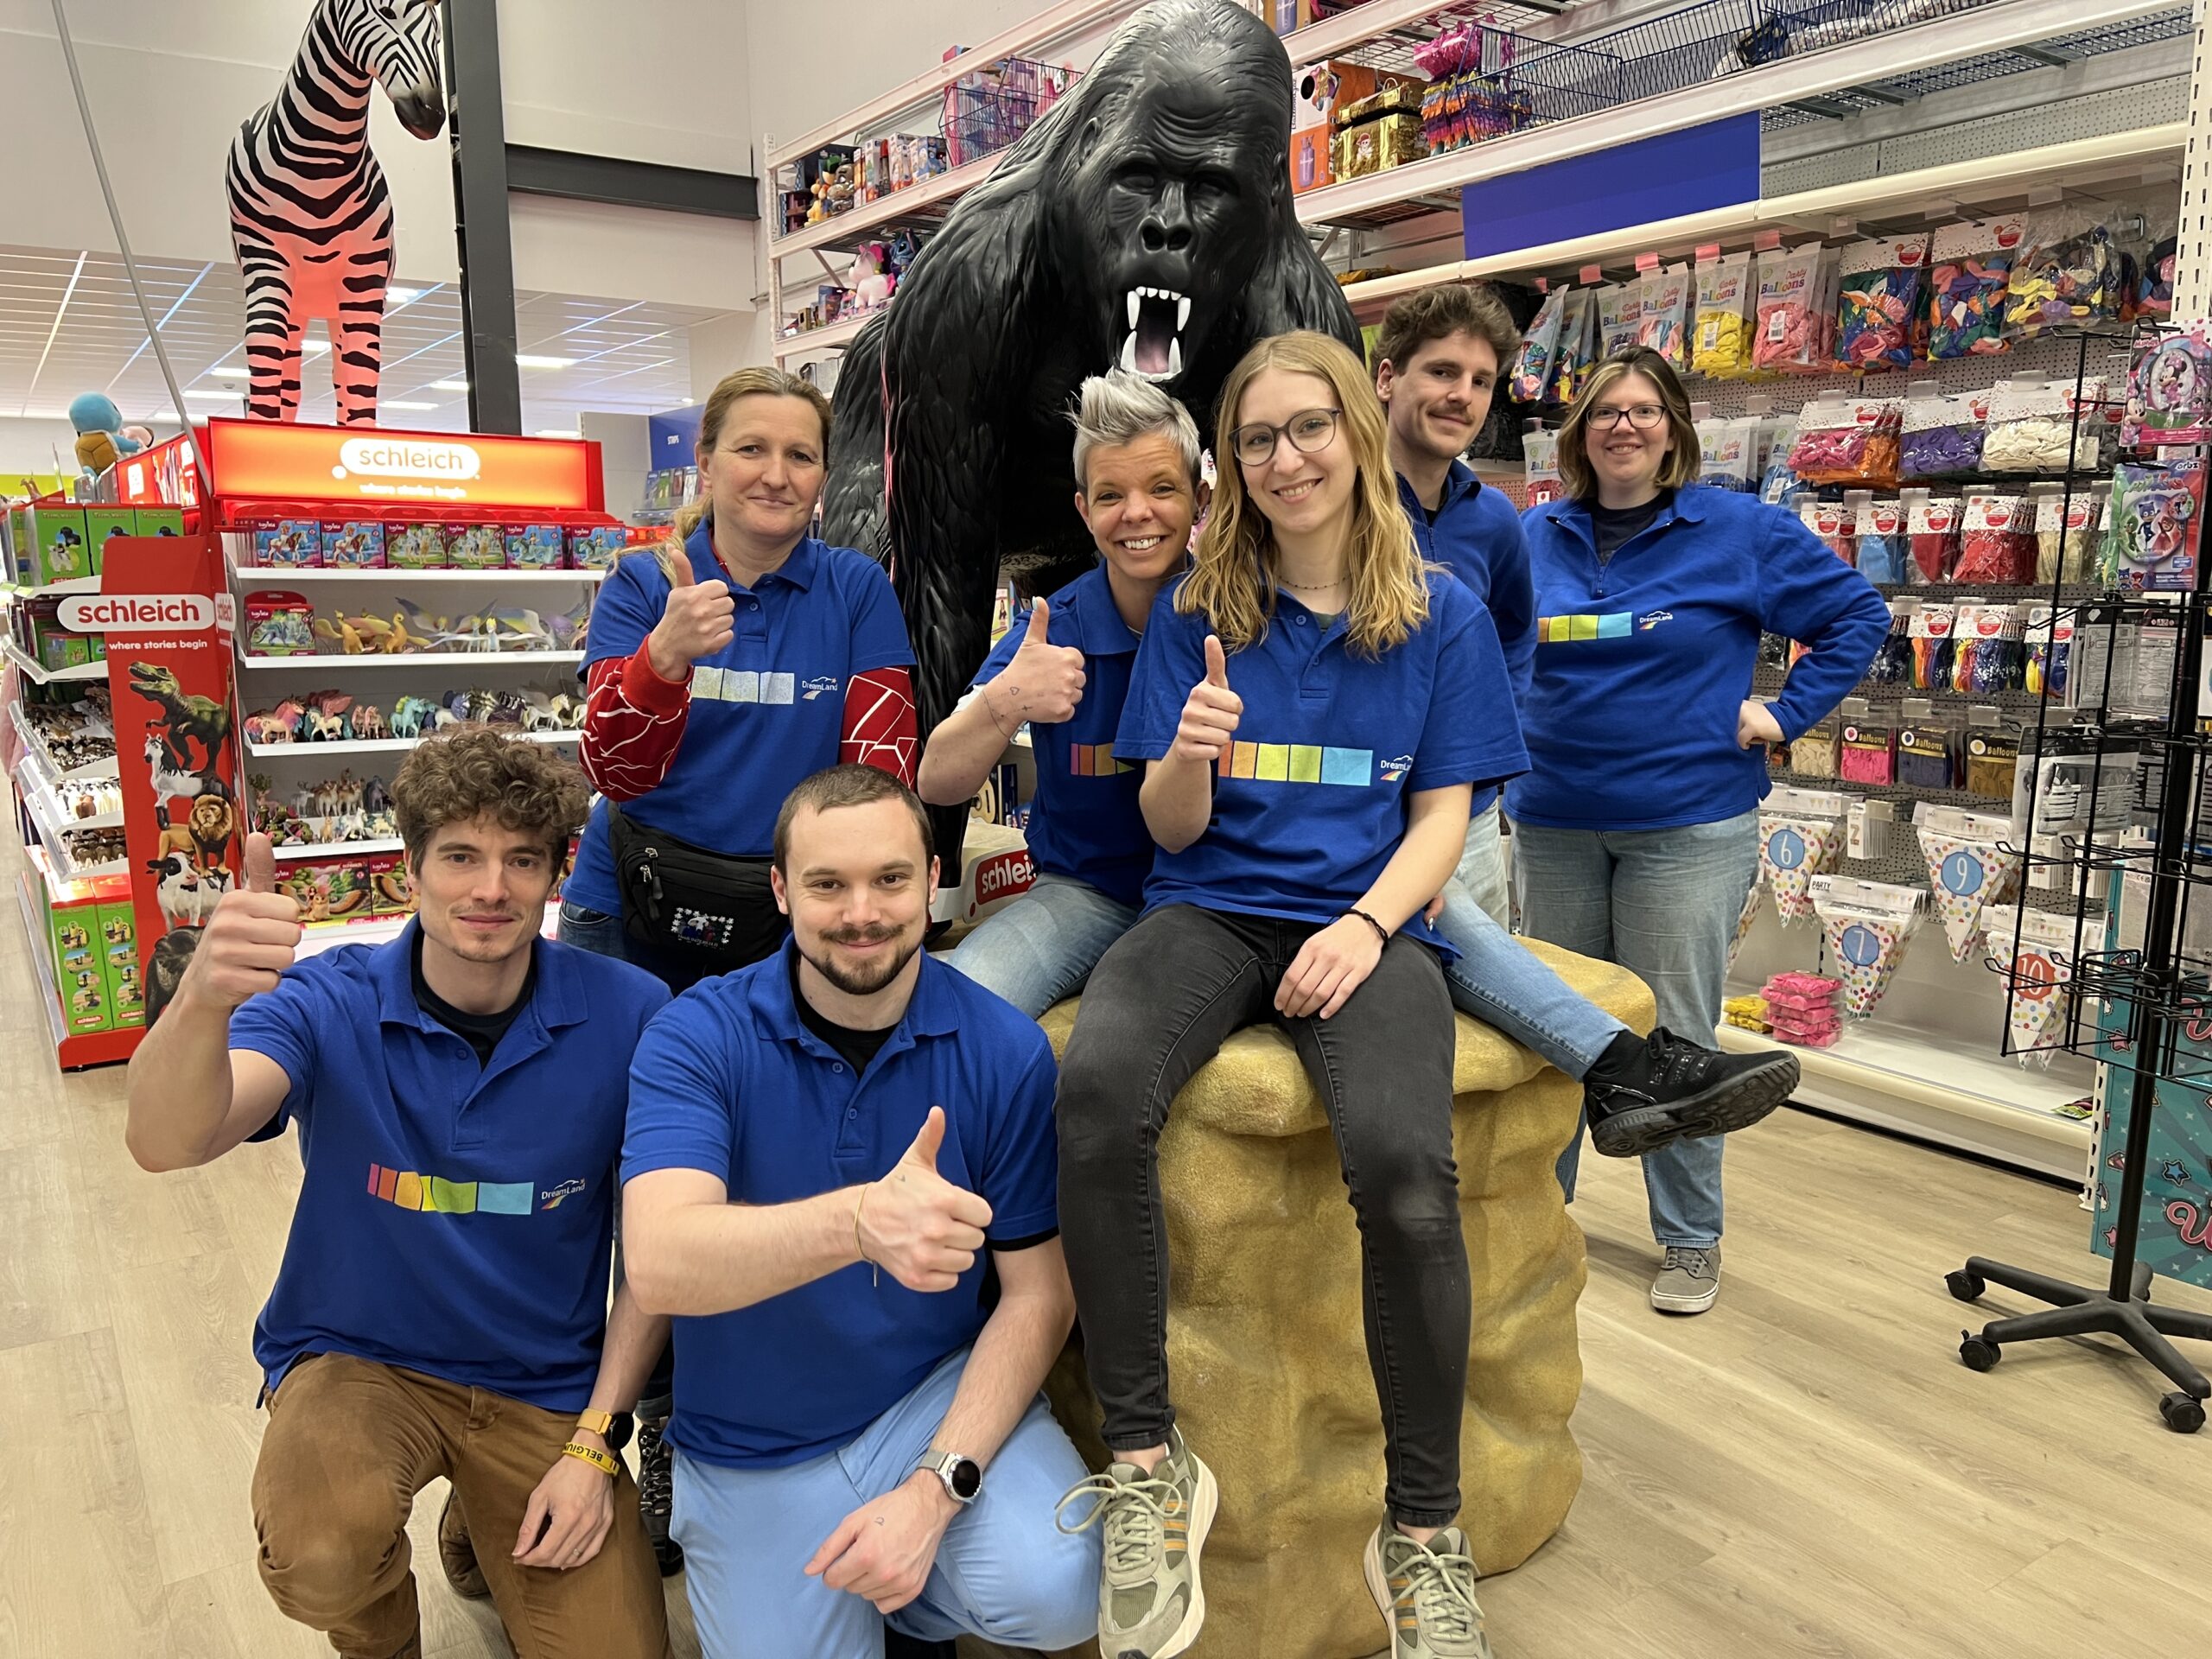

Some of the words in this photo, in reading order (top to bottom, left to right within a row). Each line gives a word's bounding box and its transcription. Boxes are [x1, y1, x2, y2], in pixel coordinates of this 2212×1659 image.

[1760, 278, 1805, 296] Balloons
[359, 446, 463, 471] schleich
[1702, 450, 1739, 462] Balloons
[2177, 461, 2199, 471] orbz
[78, 598, 200, 624] schleich
[1639, 614, 1674, 624] DreamLand
[109, 639, 142, 651] where
[143, 639, 178, 650] stories
[179, 639, 208, 652] begin
[802, 680, 838, 691] DreamLand
[1858, 734, 1885, 745] Balloons
[1915, 740, 1942, 751] Balloons
[1779, 833, 1792, 866] 6
[982, 854, 1037, 895] schlei
[1956, 855, 1968, 891] 9
[1811, 880, 1831, 890] PARTY
[1854, 930, 1866, 961] 7
[2020, 957, 2044, 995] 10
[541, 1182, 586, 1200] DreamLand
